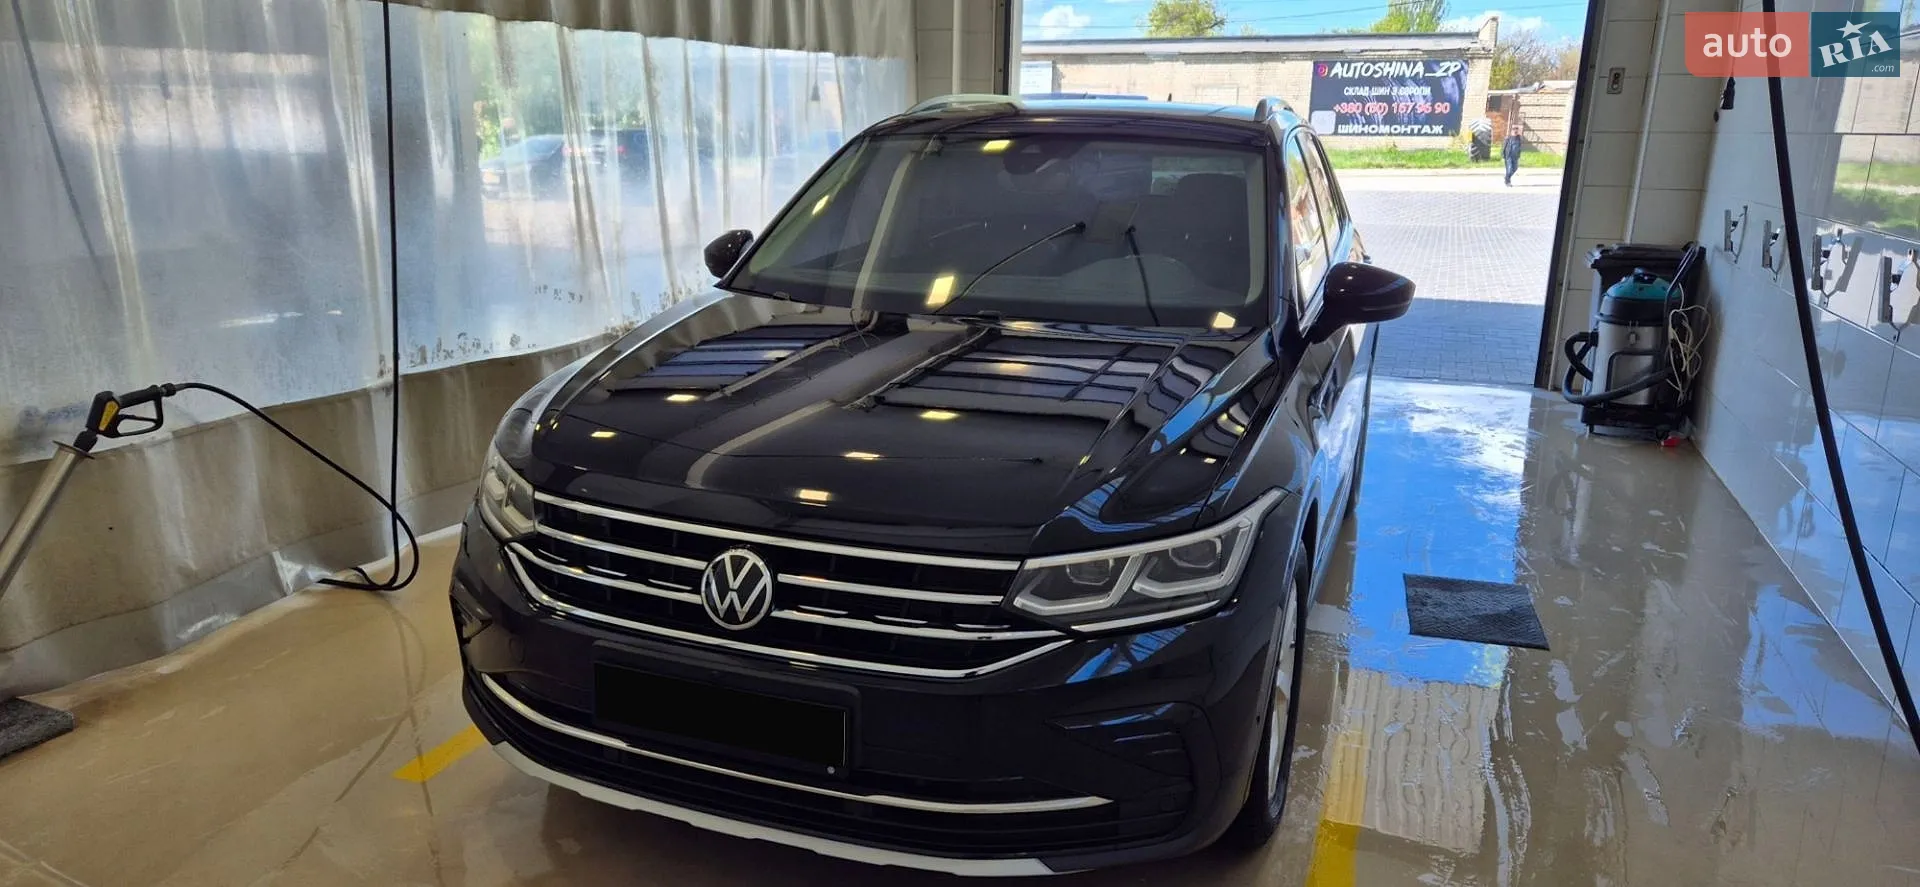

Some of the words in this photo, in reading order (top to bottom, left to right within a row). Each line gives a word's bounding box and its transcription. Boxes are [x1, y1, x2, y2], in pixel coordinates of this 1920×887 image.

[1330, 62, 1461, 78] AUTOSHINA_ZP
[1344, 86, 1368, 97] СКЛАД
[1371, 86, 1390, 96] ШИН
[1333, 102, 1362, 114] +380
[1434, 102, 1451, 114] 90
[1337, 125, 1444, 134] ШИНОМОНТАЖ
